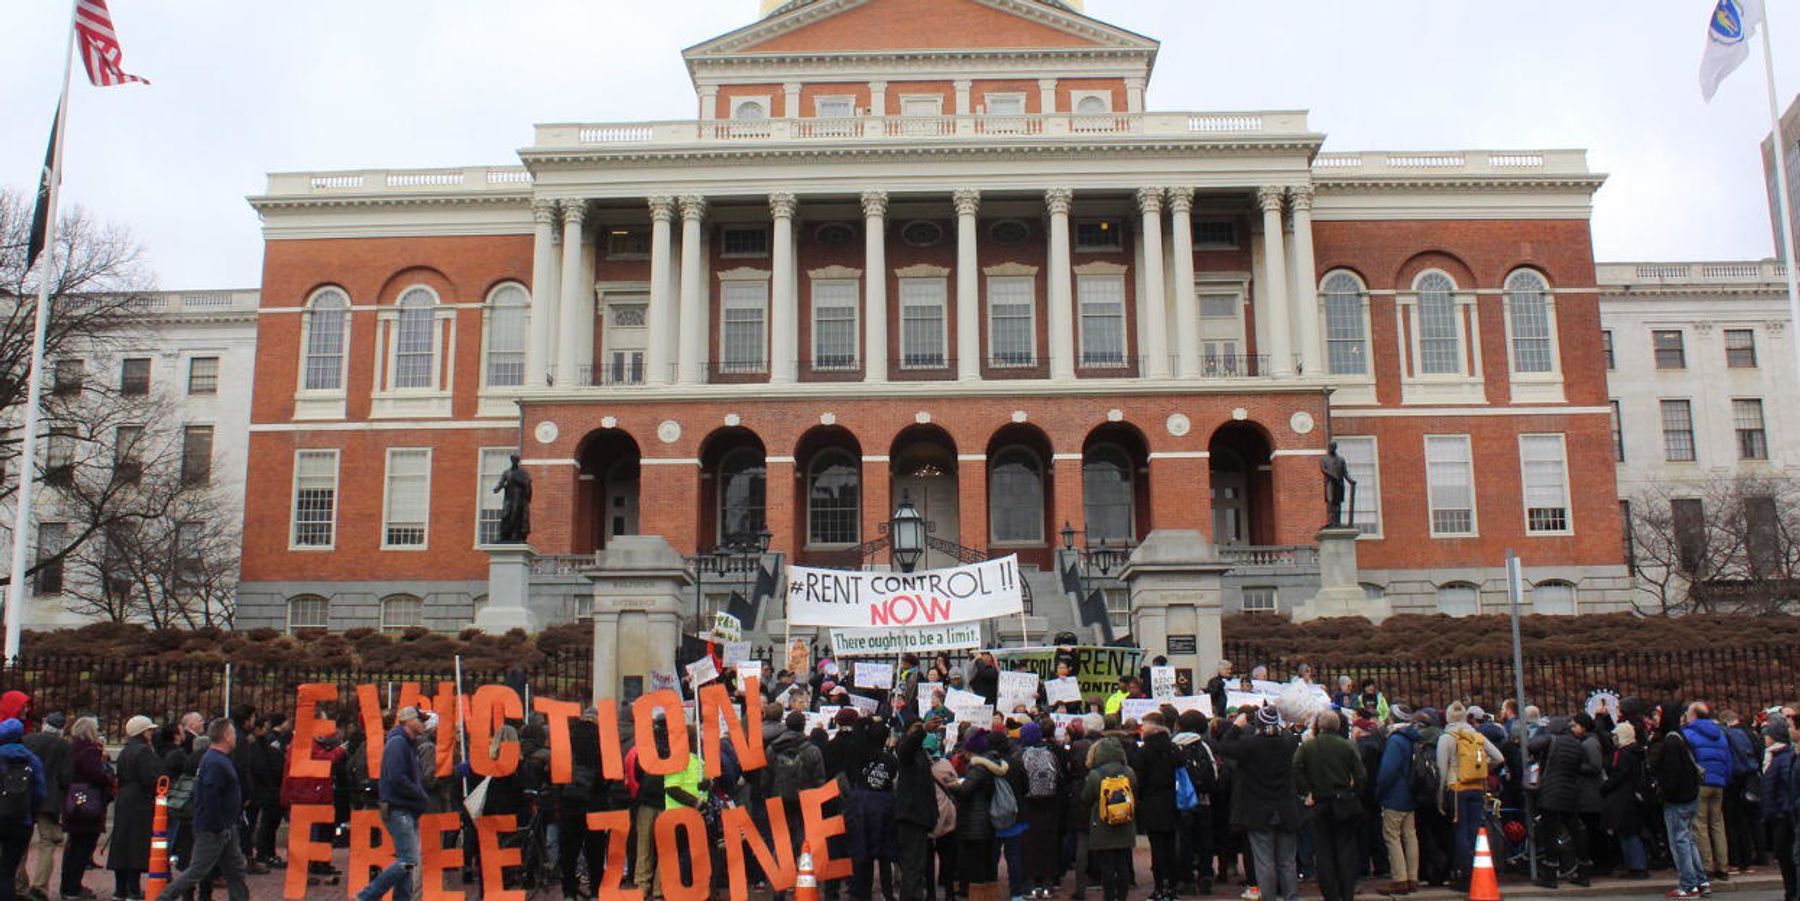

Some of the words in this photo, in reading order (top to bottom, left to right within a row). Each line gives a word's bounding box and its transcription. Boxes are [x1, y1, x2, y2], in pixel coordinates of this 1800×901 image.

[790, 572, 863, 604] #RENT
[871, 568, 992, 598] CONTROL
[1000, 560, 1014, 591] !!
[870, 594, 951, 625] NOW
[834, 633, 865, 650] There
[869, 631, 902, 654] ought
[904, 632, 916, 648] to
[919, 631, 934, 645] be
[937, 633, 943, 644] a
[946, 628, 979, 643] limit.
[1077, 648, 1140, 675] RENT
[1079, 681, 1118, 694] CONTR
[289, 676, 766, 784] EVICTION
[284, 804, 526, 901] FREE
[586, 778, 853, 901] ZONE
